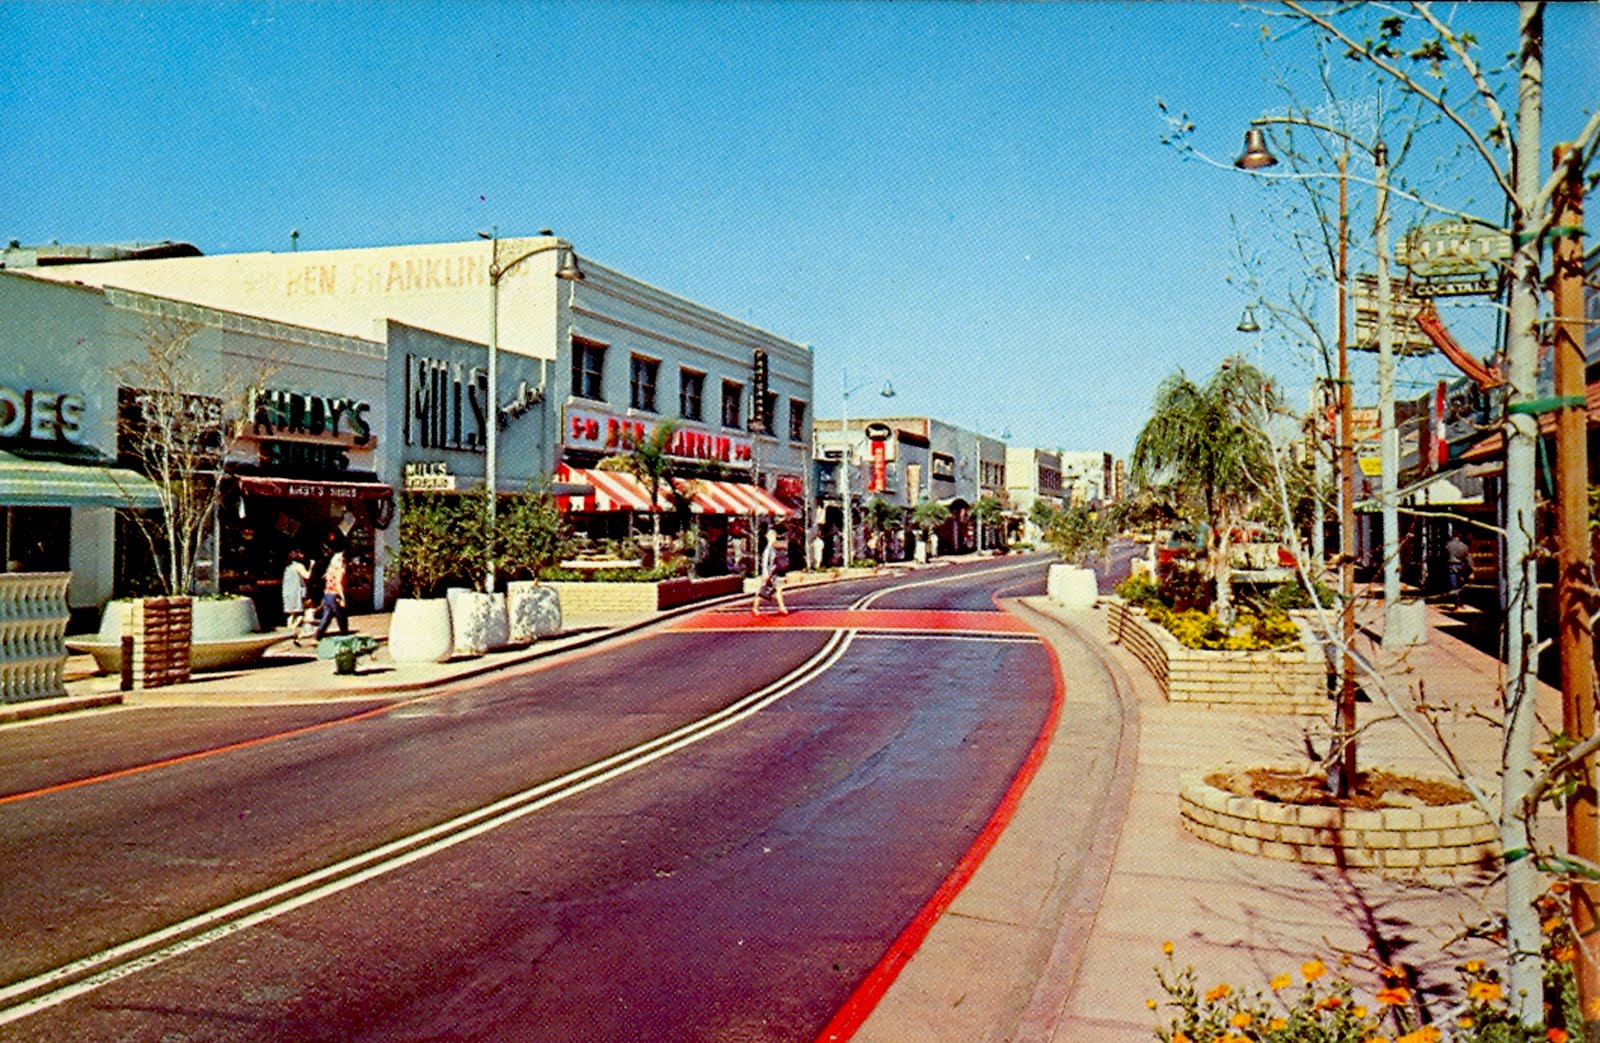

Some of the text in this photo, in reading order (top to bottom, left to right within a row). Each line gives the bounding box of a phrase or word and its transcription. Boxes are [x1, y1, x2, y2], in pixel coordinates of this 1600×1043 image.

[286, 264, 337, 296] BEN
[350, 254, 486, 295] FRANKLIN
[404, 353, 488, 453] MILLS
